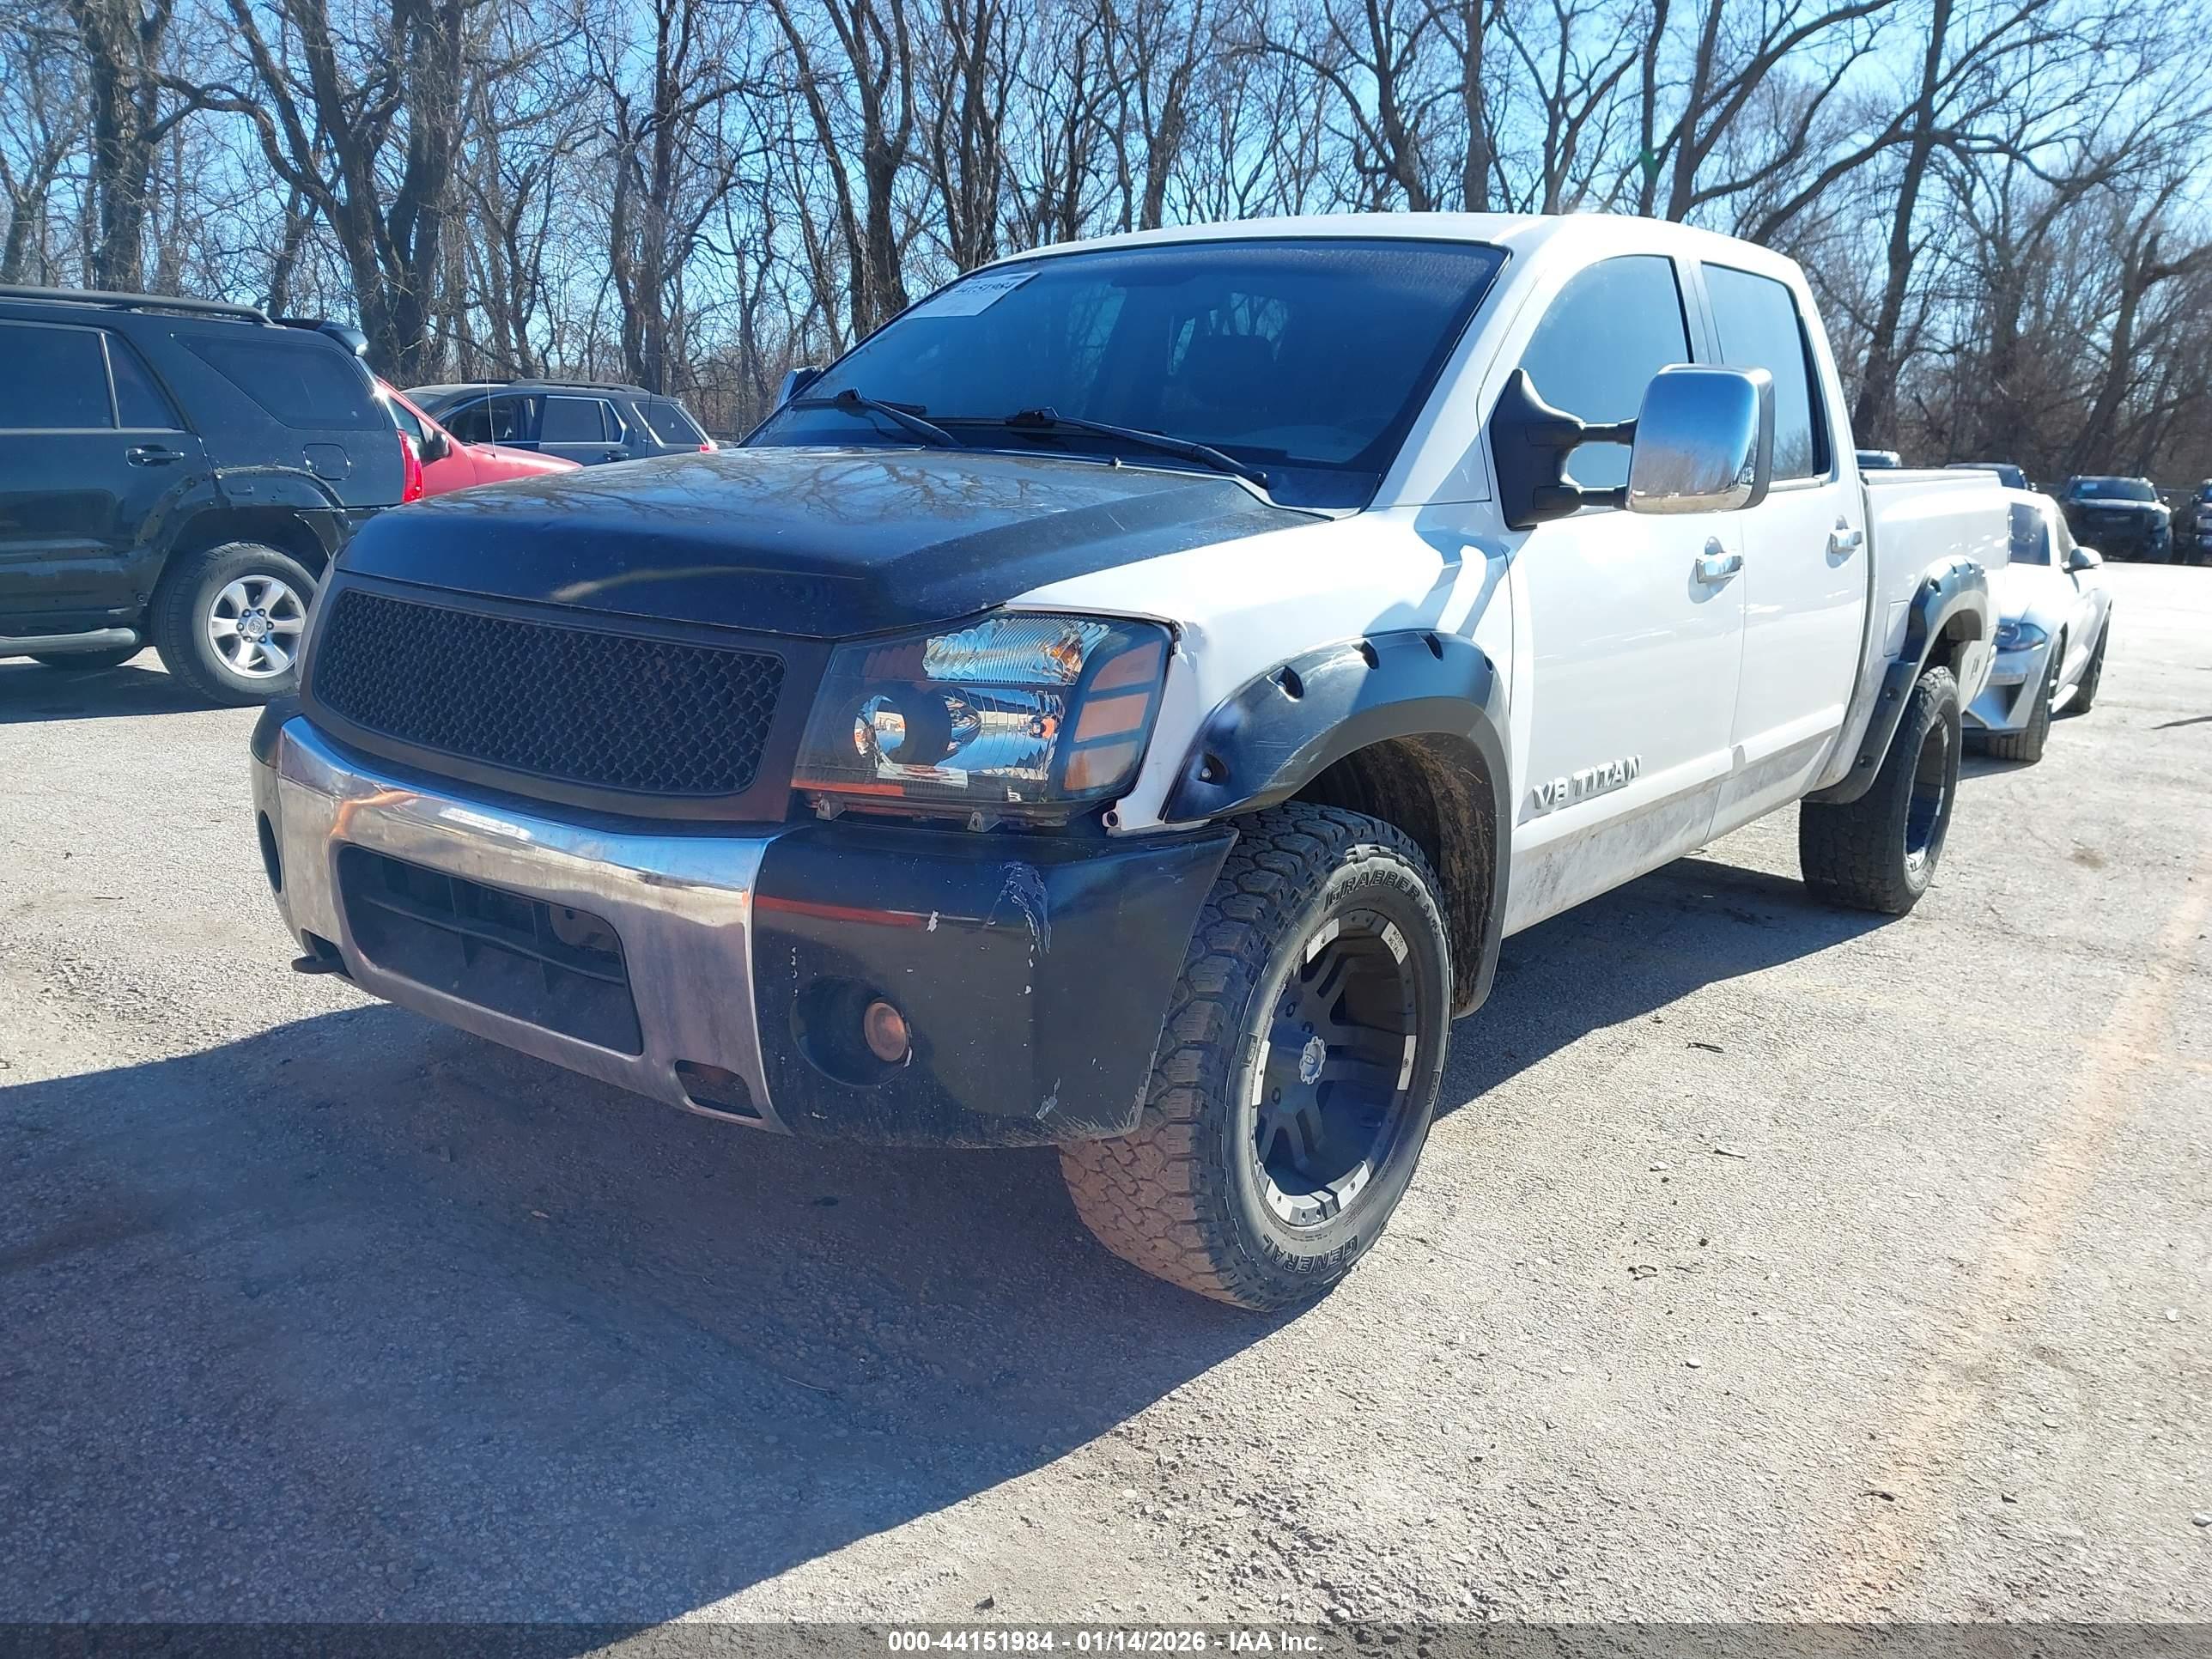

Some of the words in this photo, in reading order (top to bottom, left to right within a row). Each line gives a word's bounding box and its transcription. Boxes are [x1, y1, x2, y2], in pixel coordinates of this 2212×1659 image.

[1532, 776, 1569, 810] V8
[1571, 754, 1642, 797] TITAN
[1323, 869, 1421, 912] GRABBER
[1387, 936, 1400, 956] METAL
[1392, 929, 1404, 948] MOTO
[1262, 1232, 1358, 1273] GENERAL
